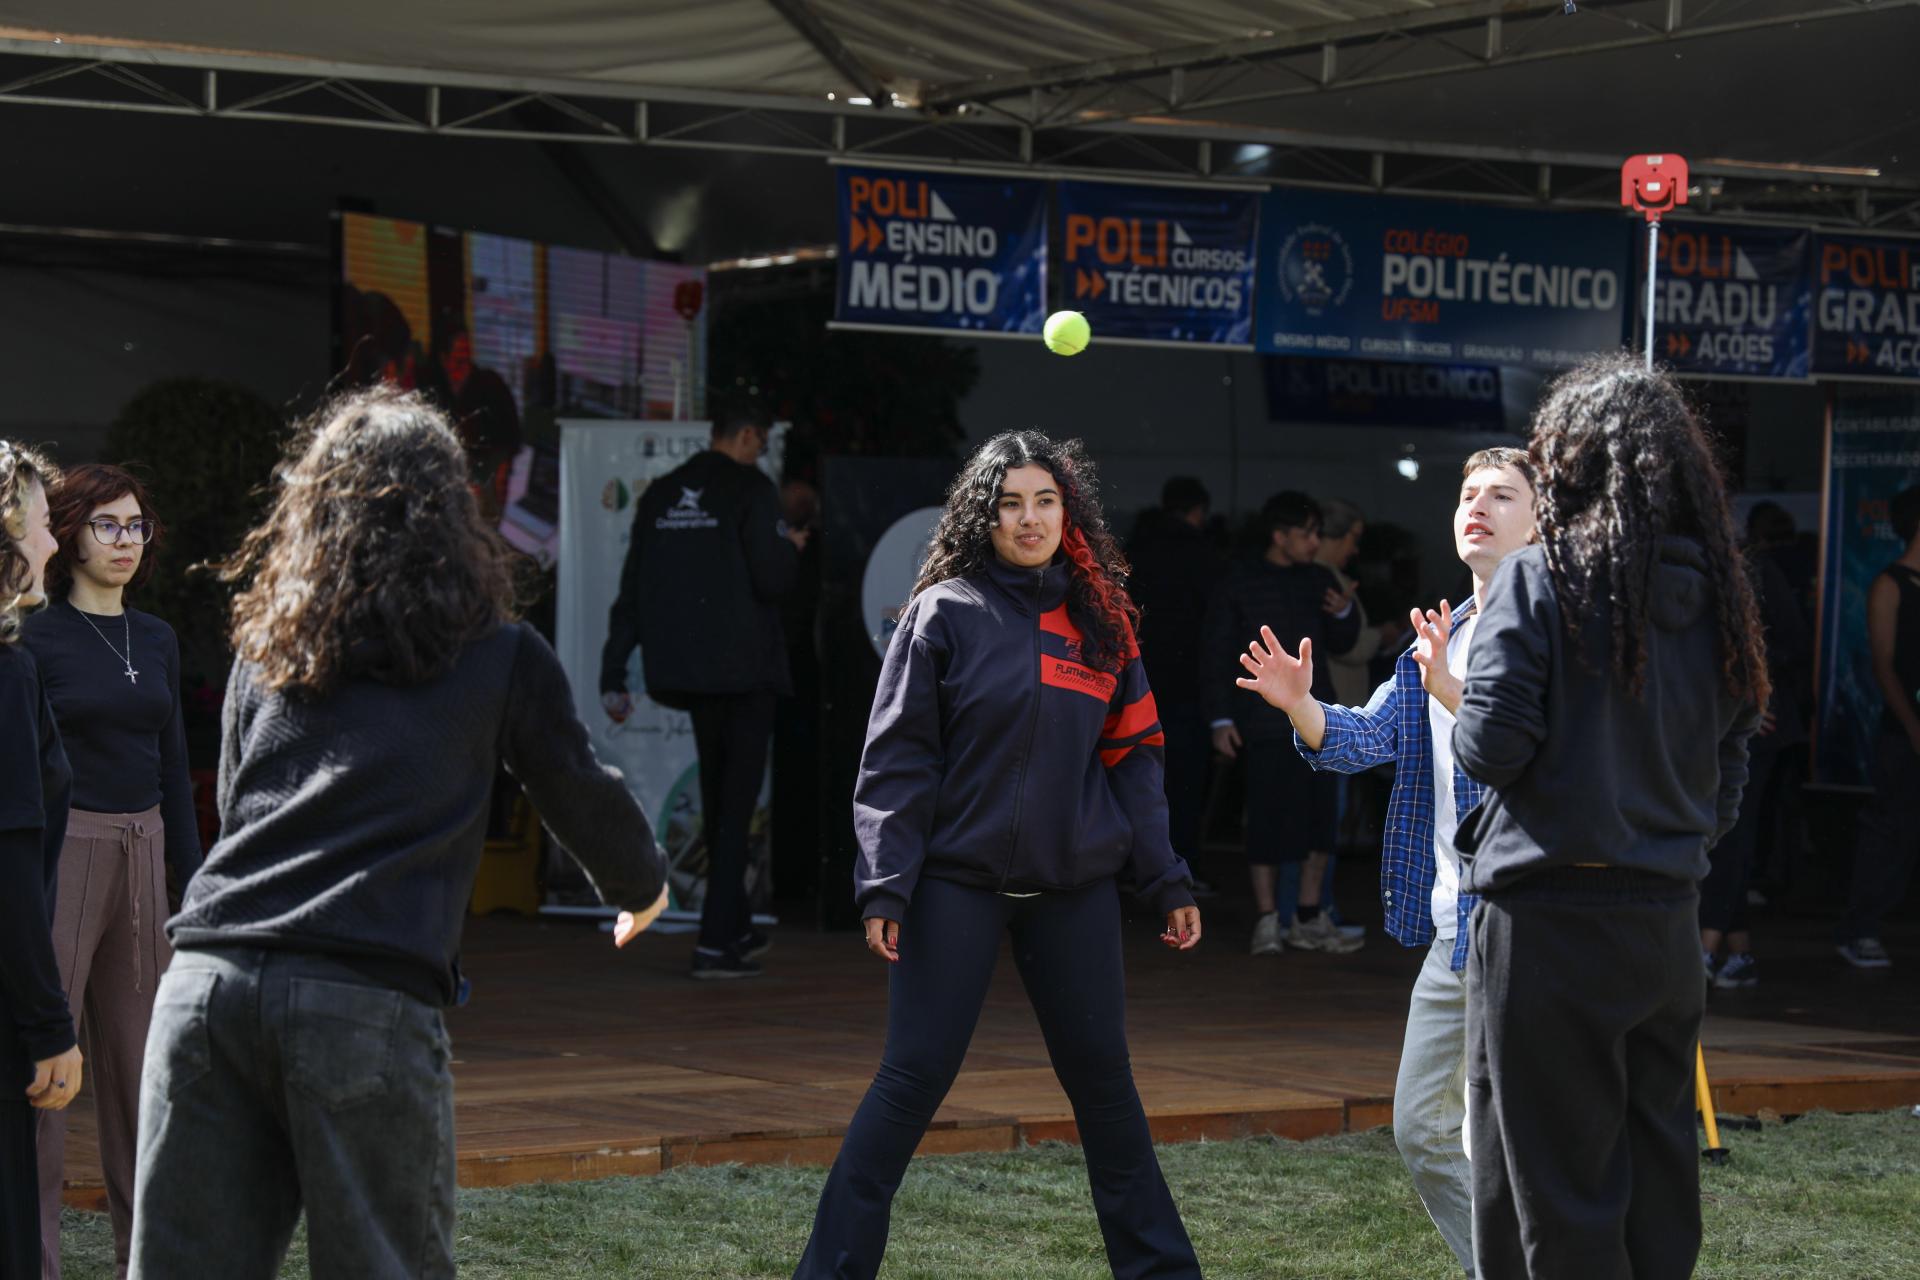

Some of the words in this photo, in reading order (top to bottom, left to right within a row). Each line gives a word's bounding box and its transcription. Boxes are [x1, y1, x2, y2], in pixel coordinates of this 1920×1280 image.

[849, 176, 928, 218] POLI
[887, 221, 997, 257] ENSINO
[1065, 214, 1168, 267] POLI
[1172, 248, 1246, 272] CURSOS
[1384, 228, 1469, 257] COLÉGIO
[1644, 230, 1732, 279] POLI
[848, 253, 997, 314] MÉDIO
[1106, 265, 1242, 310] TÉCNICOS
[1382, 252, 1618, 310] POLITÉCNICO
[1821, 245, 1909, 289] POLI
[1381, 297, 1440, 322] UFSM
[1697, 325, 1774, 367] AÇÕES
